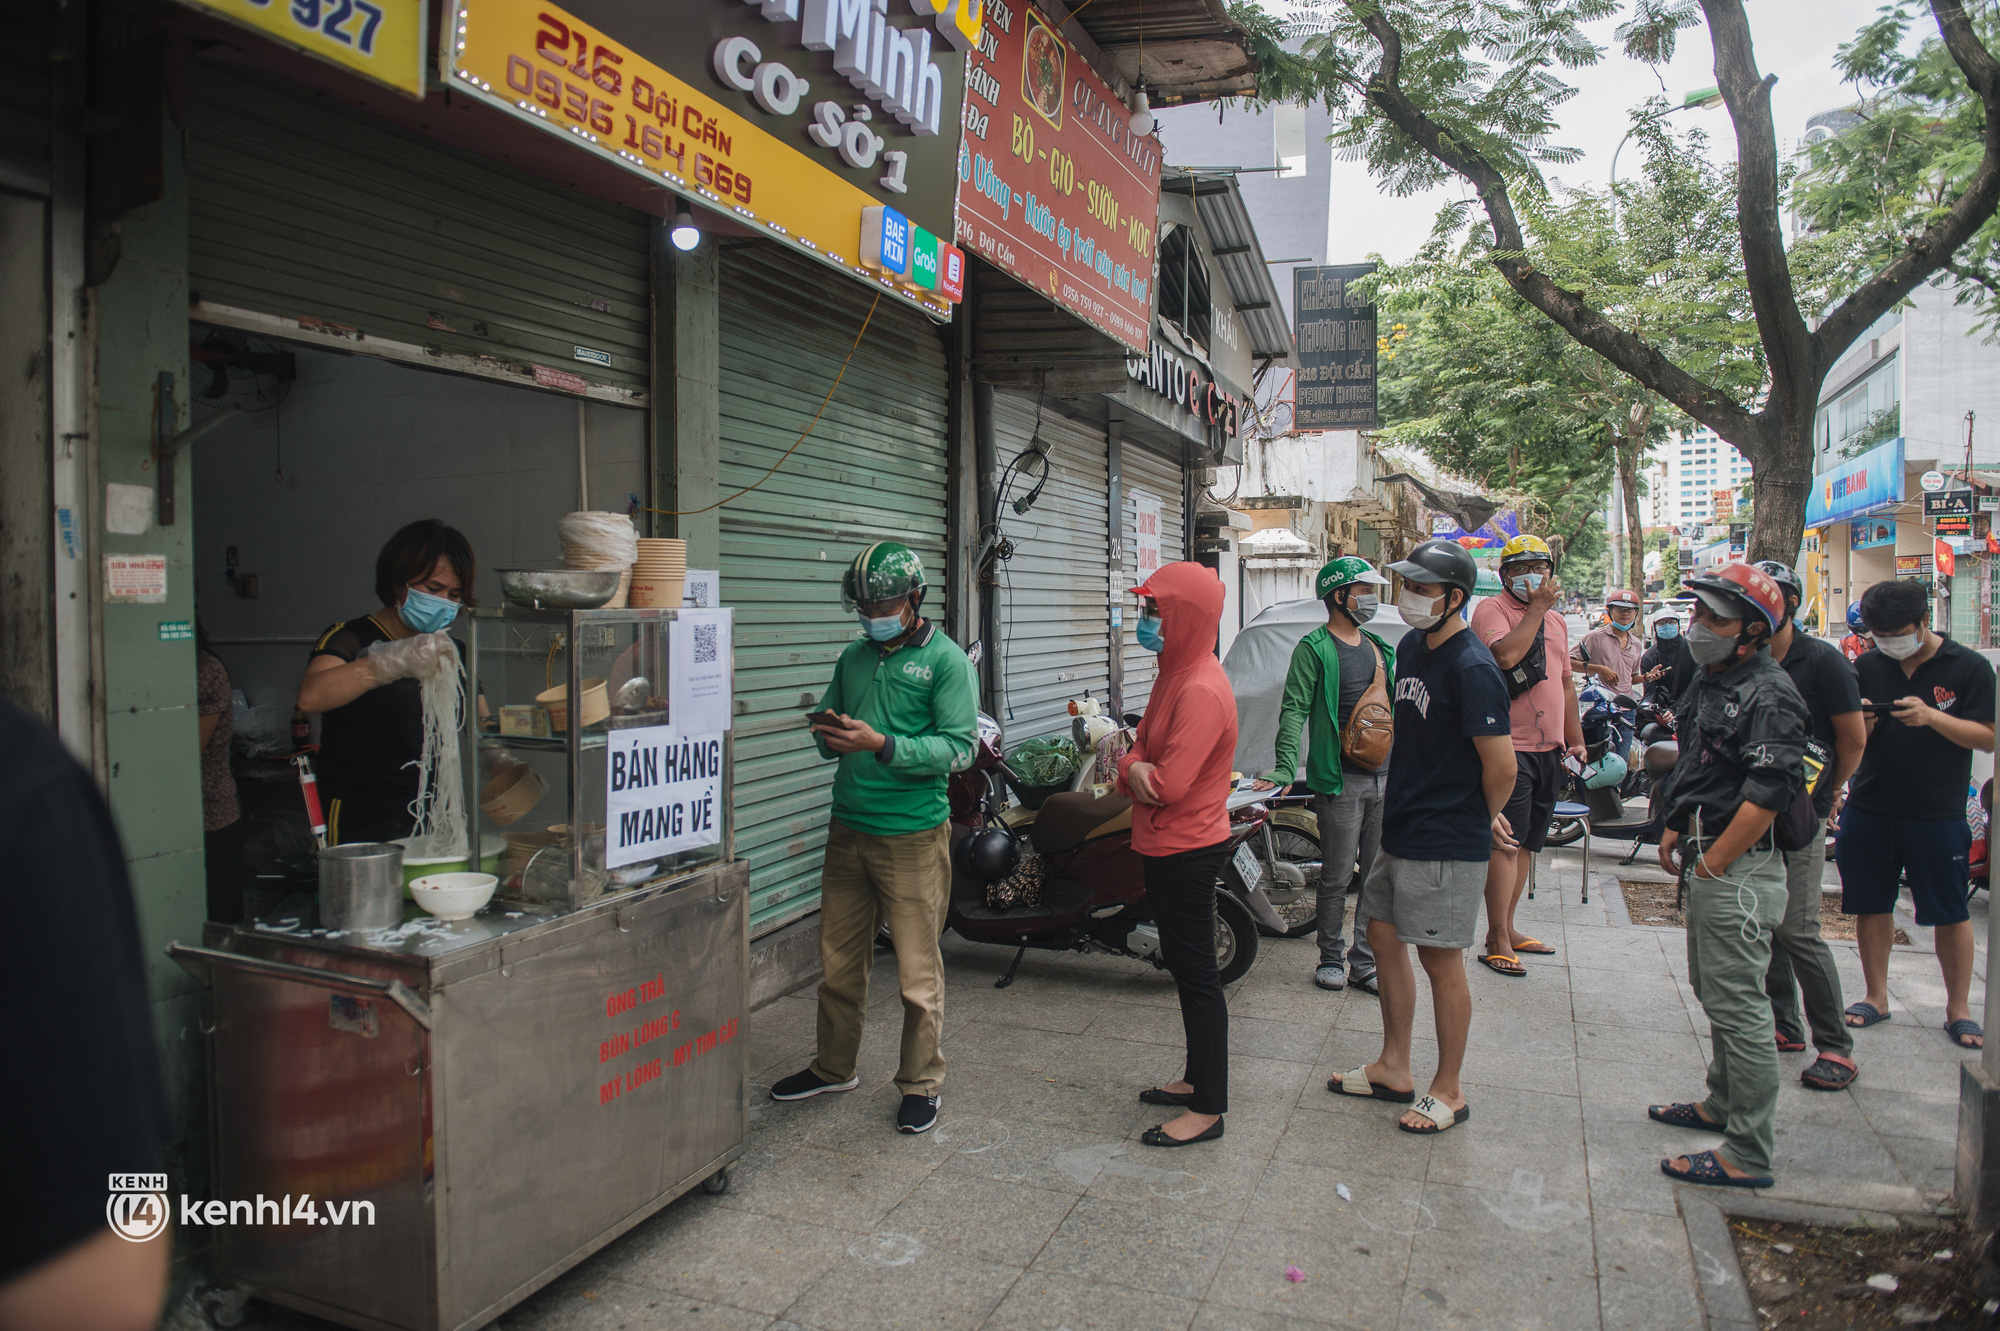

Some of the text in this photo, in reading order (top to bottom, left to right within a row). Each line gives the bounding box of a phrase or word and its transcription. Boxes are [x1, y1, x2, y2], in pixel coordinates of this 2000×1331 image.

[536, 12, 623, 96] 216
[978, 21, 999, 62] ÚN
[506, 53, 752, 204] 0936 164 669
[967, 104, 989, 140] ĐA
[1072, 77, 1123, 143] QUANG
[880, 151, 907, 194] 1
[1011, 112, 1034, 164] BÒ
[1050, 146, 1074, 196] GIÒ
[1087, 178, 1119, 233] SƯỜN
[1128, 214, 1151, 260] MỌC
[885, 216, 905, 245] BAE
[960, 139, 971, 183] ồ
[974, 153, 1011, 221] Uống
[1024, 190, 1056, 242] Nước
[1057, 217, 1071, 262] ép
[1074, 226, 1095, 269] trái
[1094, 249, 1114, 290] cây
[1114, 262, 1130, 293] các
[1131, 268, 1148, 309] loại
[979, 230, 996, 255] Đội
[884, 237, 904, 265] MIN
[913, 247, 936, 274] Grab
[1062, 283, 1079, 303] 0356
[1080, 293, 1092, 311] 759
[1092, 301, 1105, 318] 927
[1301, 272, 1342, 311] KHÁCH
[1299, 318, 1372, 357] THƯƠNG MẠI
[1319, 361, 1343, 384] ĐỘI
[1345, 357, 1372, 380] CẤN
[1298, 384, 1372, 405] PEONY HOUSE
[1832, 468, 1868, 500] VIETBANK
[1111, 537, 1121, 560] 216
[1321, 570, 1345, 588] Grab
[902, 660, 933, 681] Grab
[611, 735, 719, 792] BÁN HÀNG
[619, 785, 714, 848] MANG VỀ
[600, 1032, 630, 1064] BÚN
[633, 1015, 669, 1048] LÒNG
[626, 1057, 662, 1092] LÒNG
[695, 1029, 717, 1056] TIM
